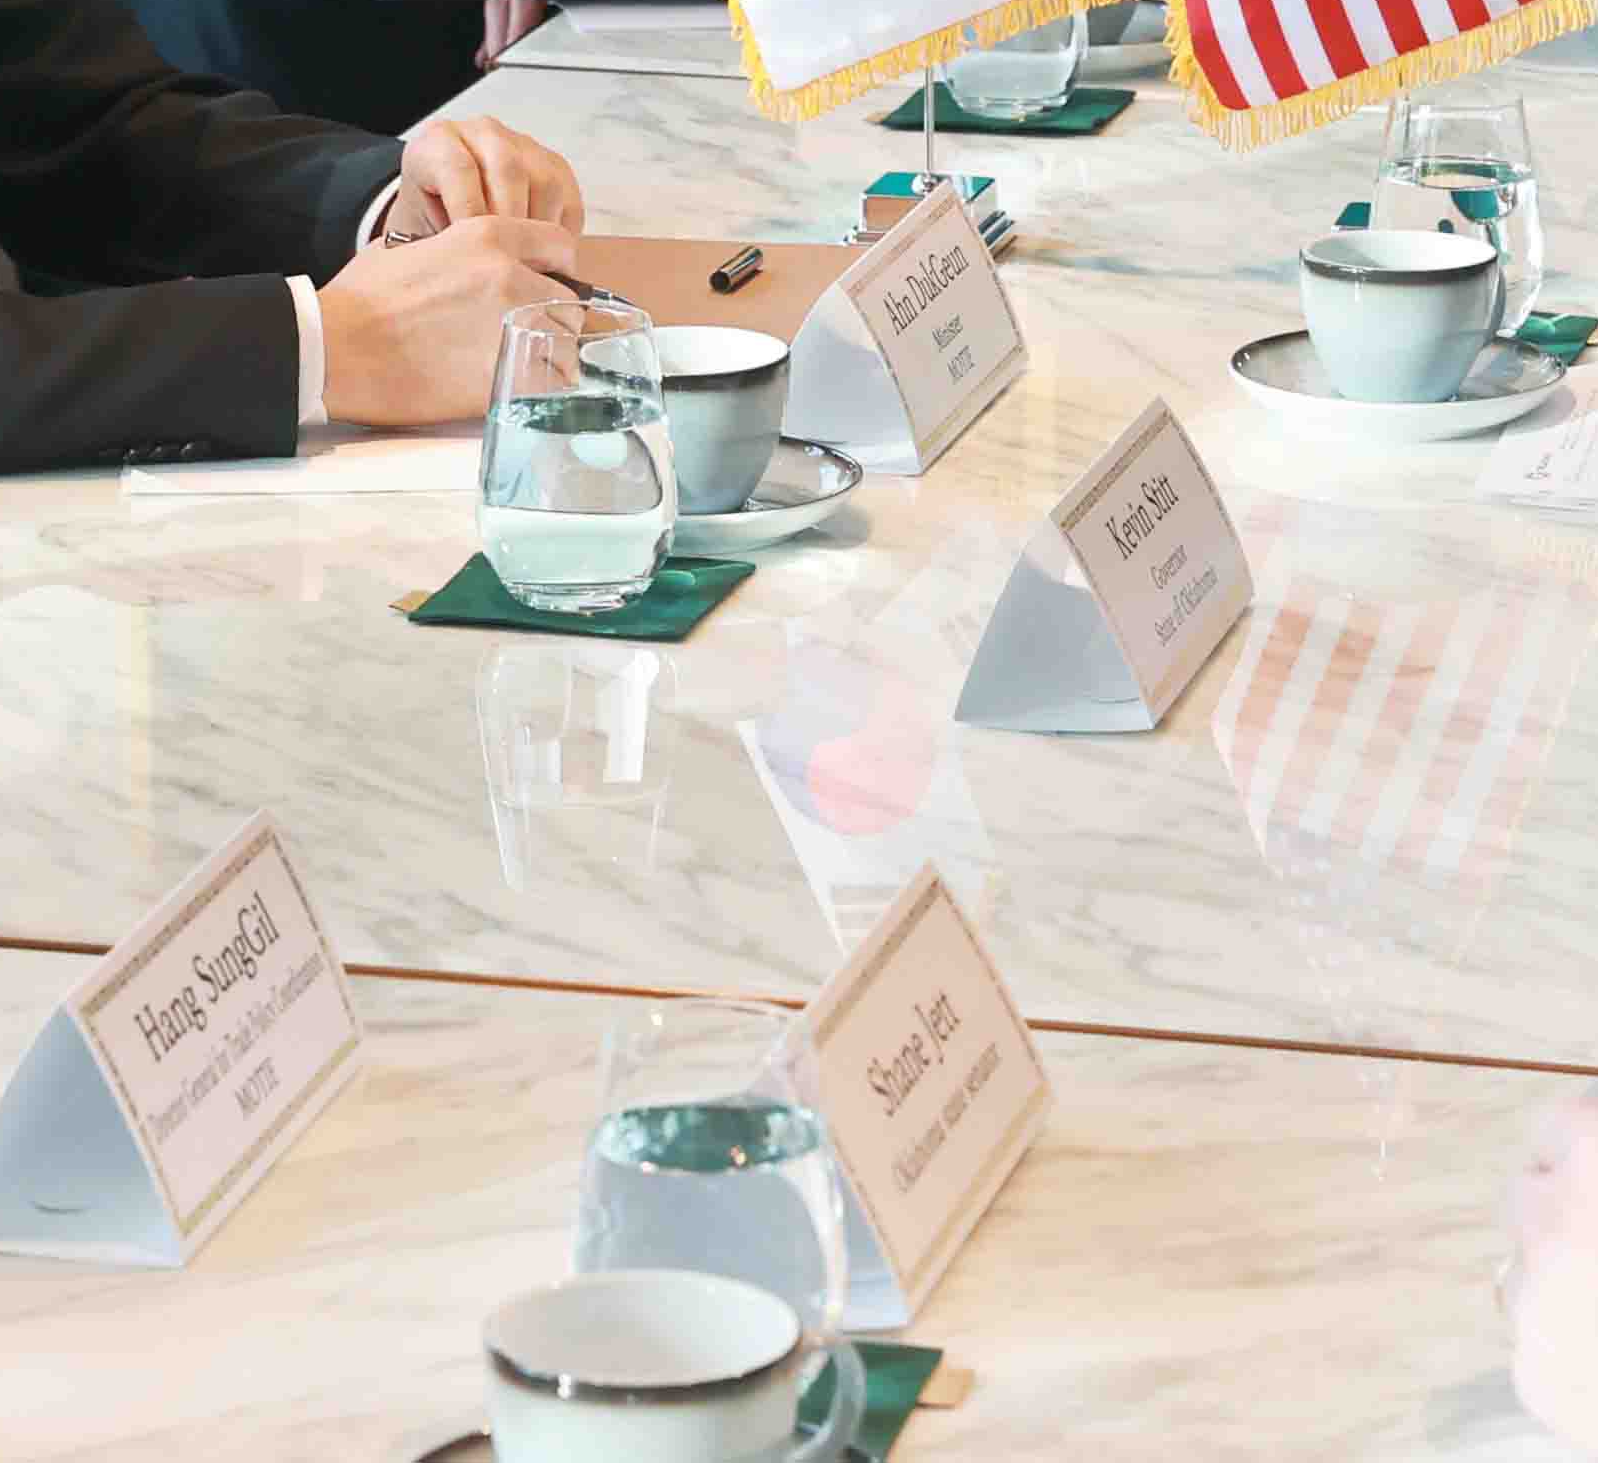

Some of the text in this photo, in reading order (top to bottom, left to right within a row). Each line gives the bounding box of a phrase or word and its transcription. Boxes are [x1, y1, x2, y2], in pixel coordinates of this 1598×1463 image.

[884, 246, 967, 333] Ahn DukGeun
[1107, 474, 1177, 558] Kevin Stitt
[1150, 545, 1186, 589] Governor
[134, 891, 279, 1061] Hang SungGil
[868, 990, 960, 1117] Shane Jett
